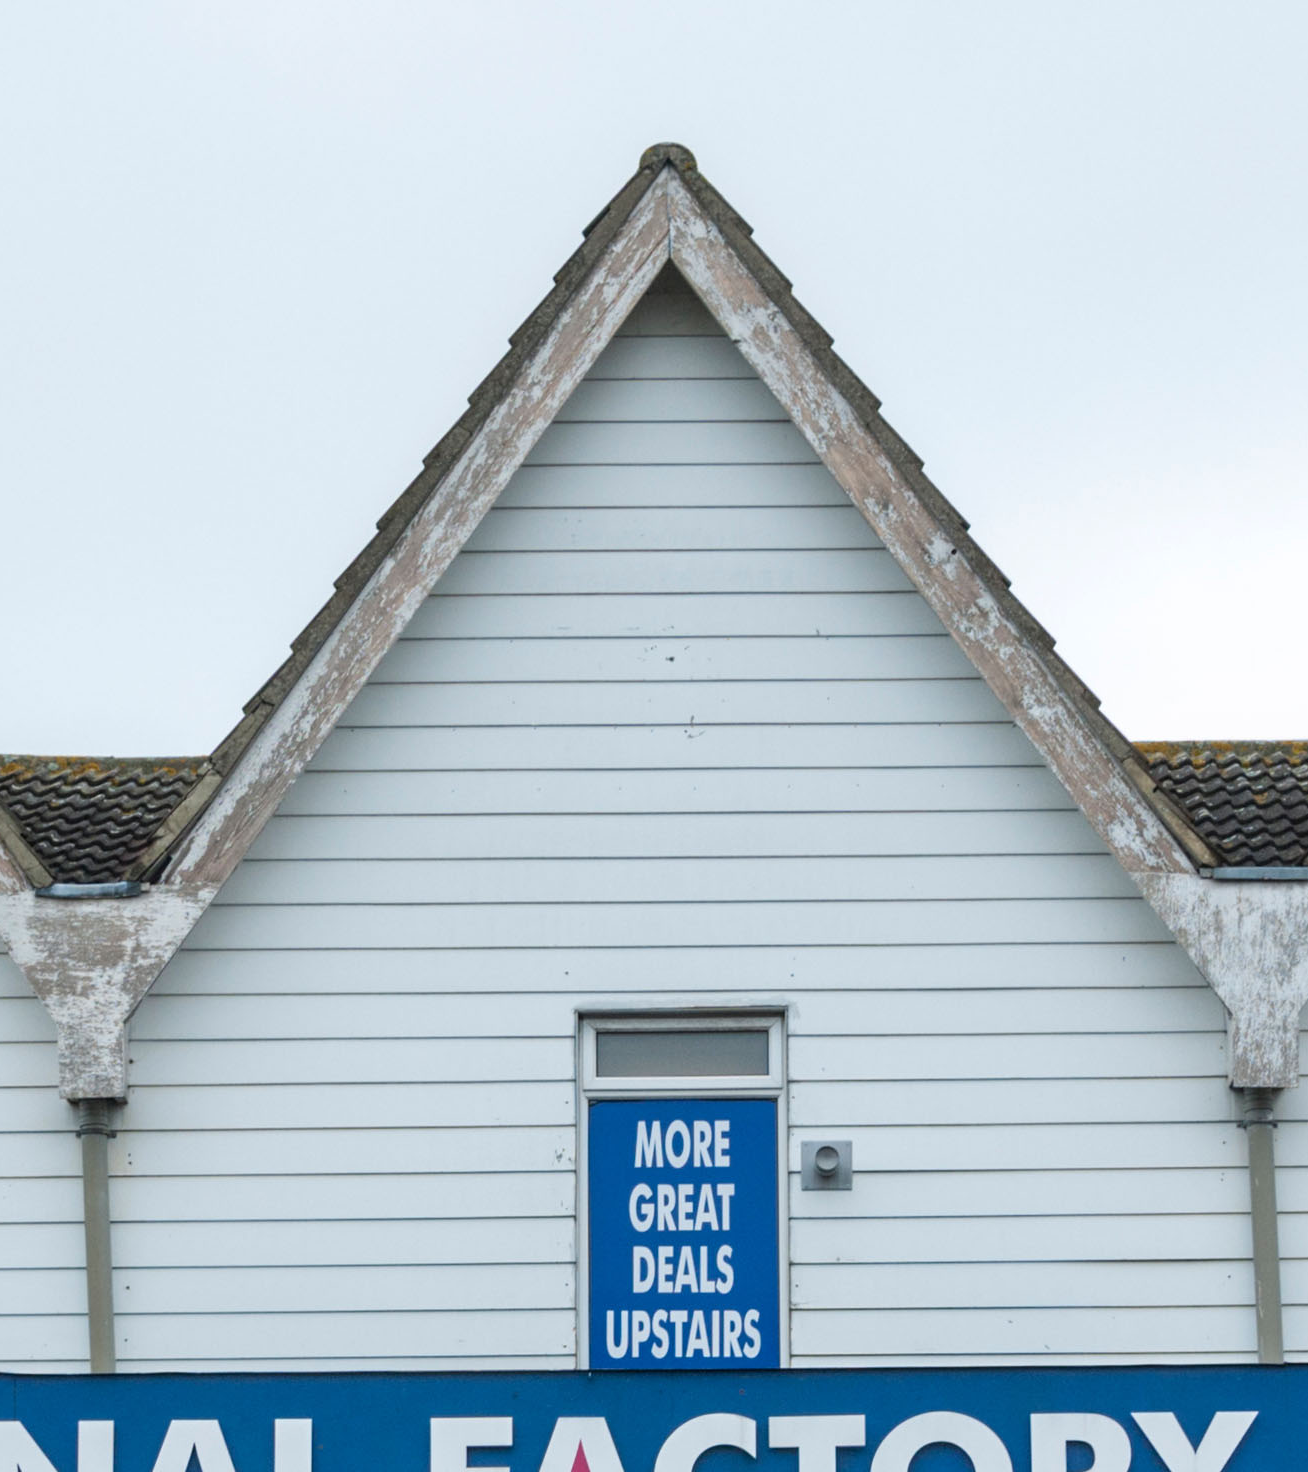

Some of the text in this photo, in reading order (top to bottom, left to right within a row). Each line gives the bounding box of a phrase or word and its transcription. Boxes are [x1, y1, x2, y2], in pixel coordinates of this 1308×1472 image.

[634, 1119, 731, 1169] MORE
[629, 1183, 735, 1233] GREAT
[633, 1244, 735, 1294] DEALS
[606, 1309, 762, 1359] UPSTAIRS
